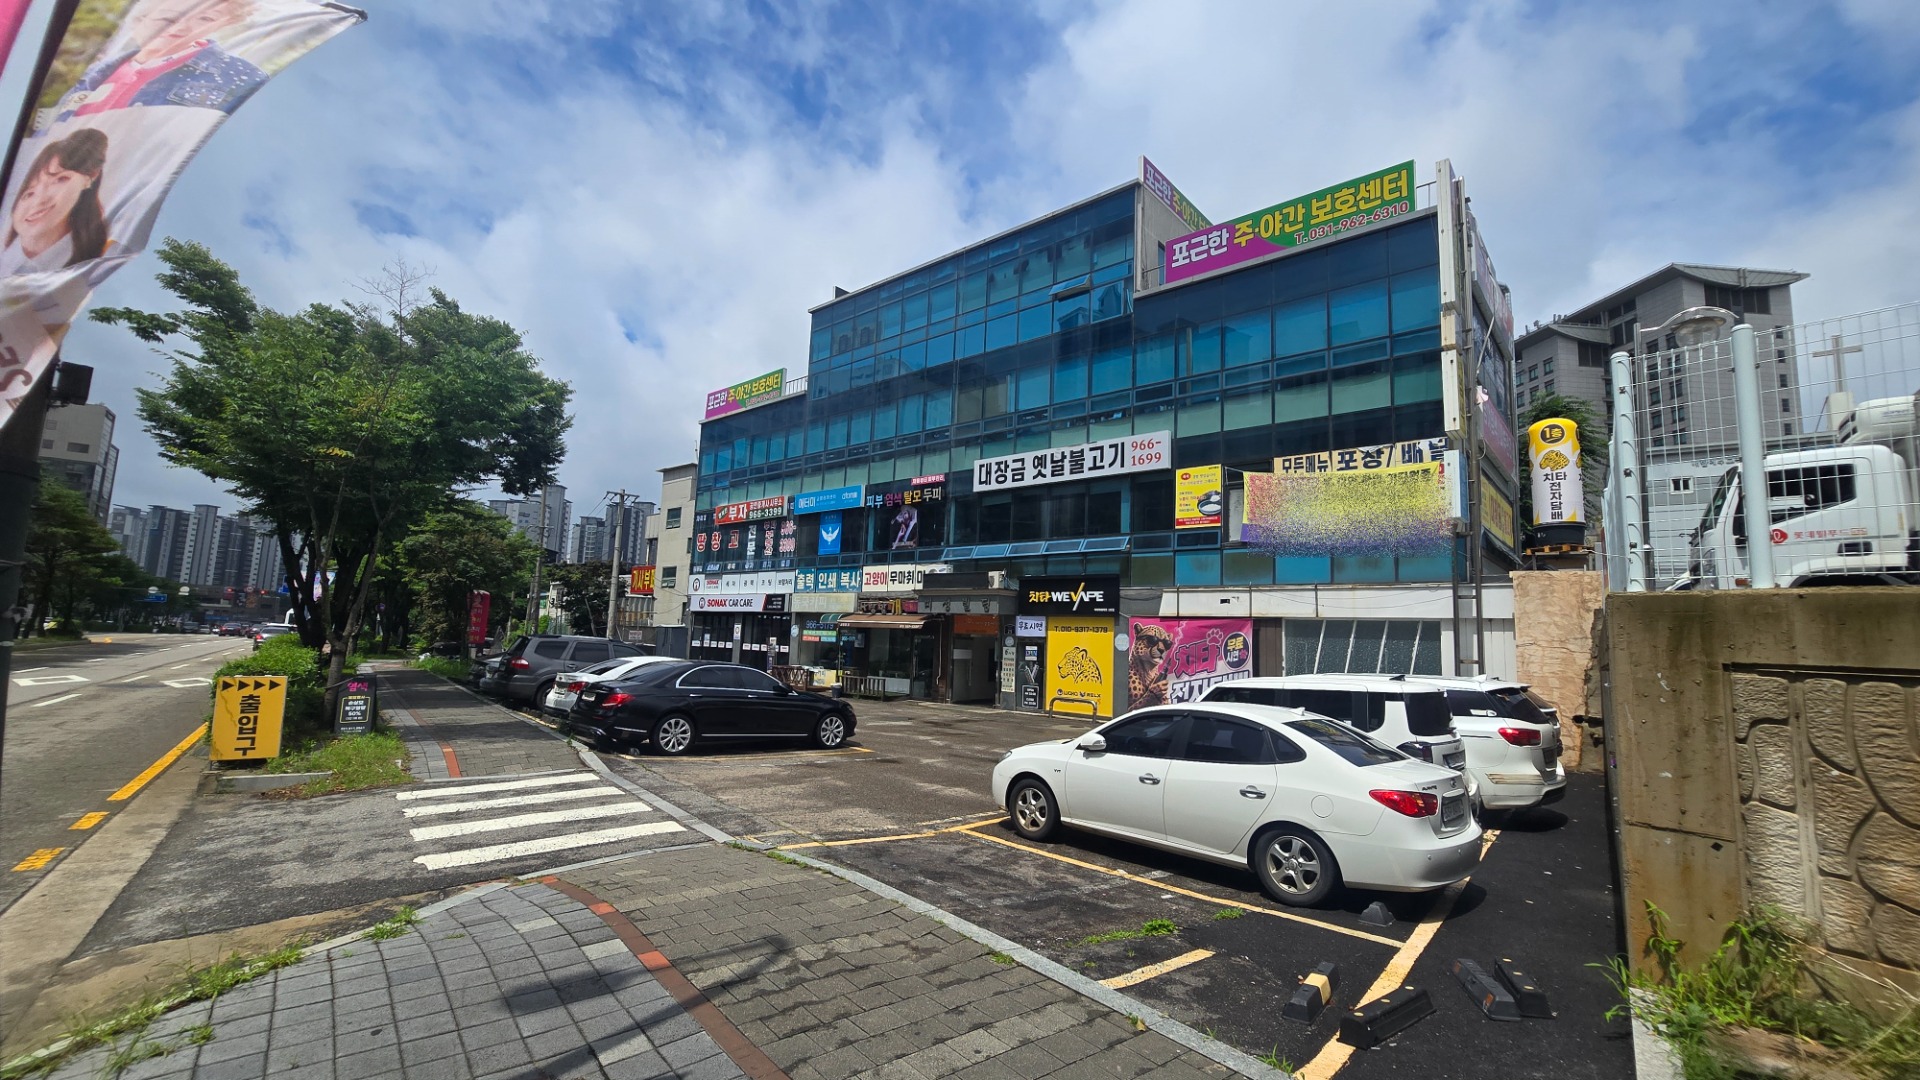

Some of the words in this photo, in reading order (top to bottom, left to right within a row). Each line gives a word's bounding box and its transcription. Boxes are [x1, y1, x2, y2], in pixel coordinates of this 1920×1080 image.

[1146, 163, 1170, 206] 포근한
[1171, 229, 1229, 268] 포근한
[1234, 204, 1305, 247] 주·야간
[1310, 169, 1408, 225] 보호센터
[707, 391, 728, 410] 포근한
[751, 373, 781, 395] 보호센터
[1544, 427, 1562, 439] 1층
[1131, 438, 1162, 452] 966-
[978, 457, 1025, 486] 대장금
[1032, 441, 1125, 480] 옛날불고기
[1131, 452, 1162, 467] 1699
[1543, 472, 1567, 482] 치타
[866, 494, 883, 508] 피부
[885, 492, 902, 507] 염색
[903, 490, 922, 505] 탈모
[922, 486, 942, 502] 두피
[1549, 482, 1564, 520] 전자담배
[729, 503, 747, 520] 부자
[697, 533, 707, 552] 땅
[797, 572, 815, 588] 출력
[818, 572, 837, 589] 인쇄
[840, 571, 861, 588] 복사
[864, 572, 887, 586] 고양이
[890, 570, 914, 586] 무마취
[707, 598, 728, 608] SONAX
[729, 598, 739, 607] CAR
[739, 598, 753, 607] CARE
[1227, 636, 1244, 651] 무료
[1174, 640, 1220, 677] 치타
[1226, 651, 1239, 662] 시연
[234, 694, 262, 756] 출입구
